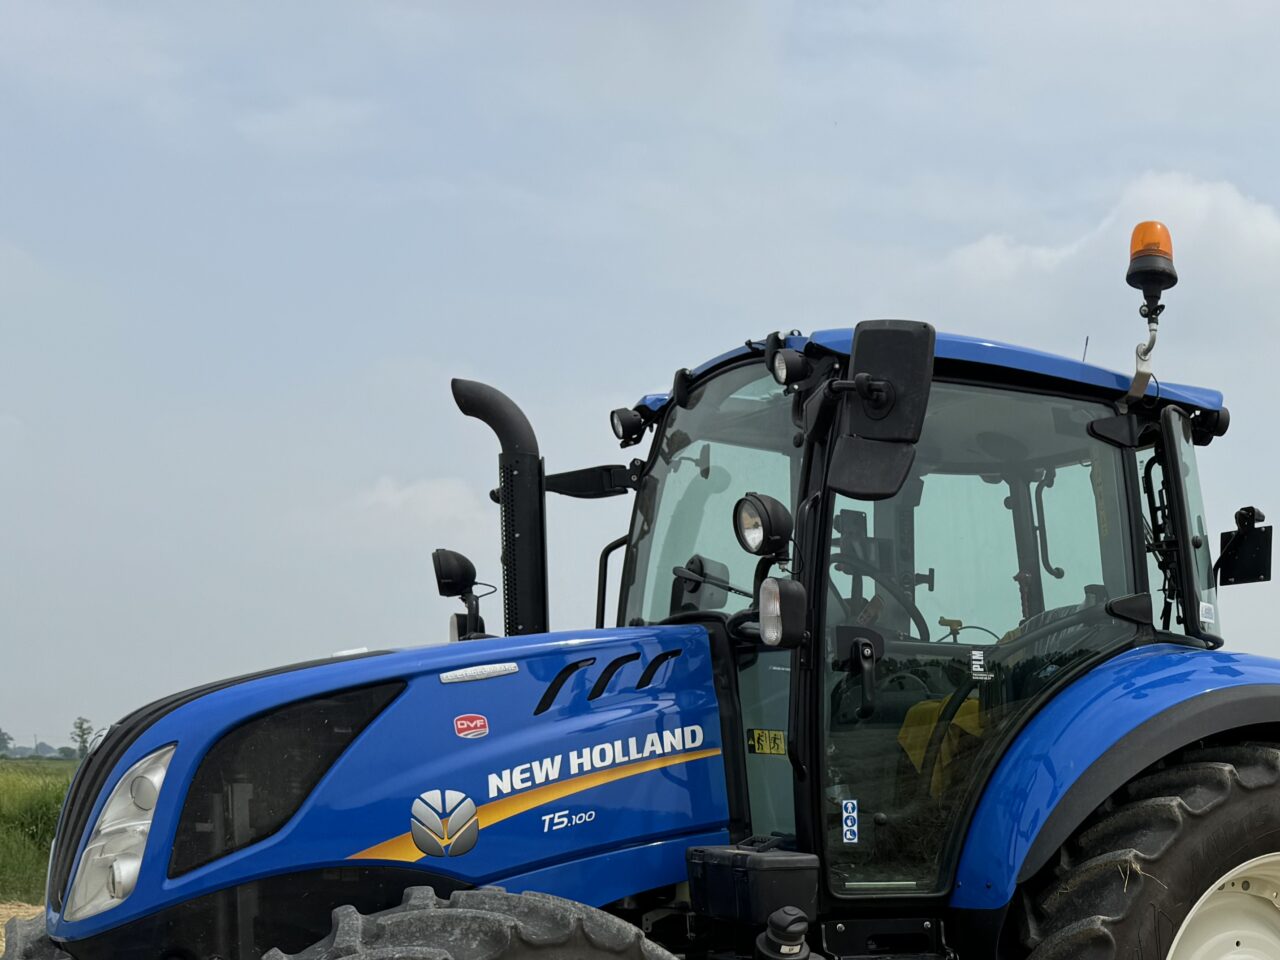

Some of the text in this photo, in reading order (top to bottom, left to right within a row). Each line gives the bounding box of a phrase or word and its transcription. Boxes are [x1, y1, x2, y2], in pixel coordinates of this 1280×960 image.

[972, 650, 984, 671] PLM
[457, 719, 485, 729] DVF
[487, 724, 704, 799] NEW HOLLAND
[541, 809, 596, 833] T5.100
